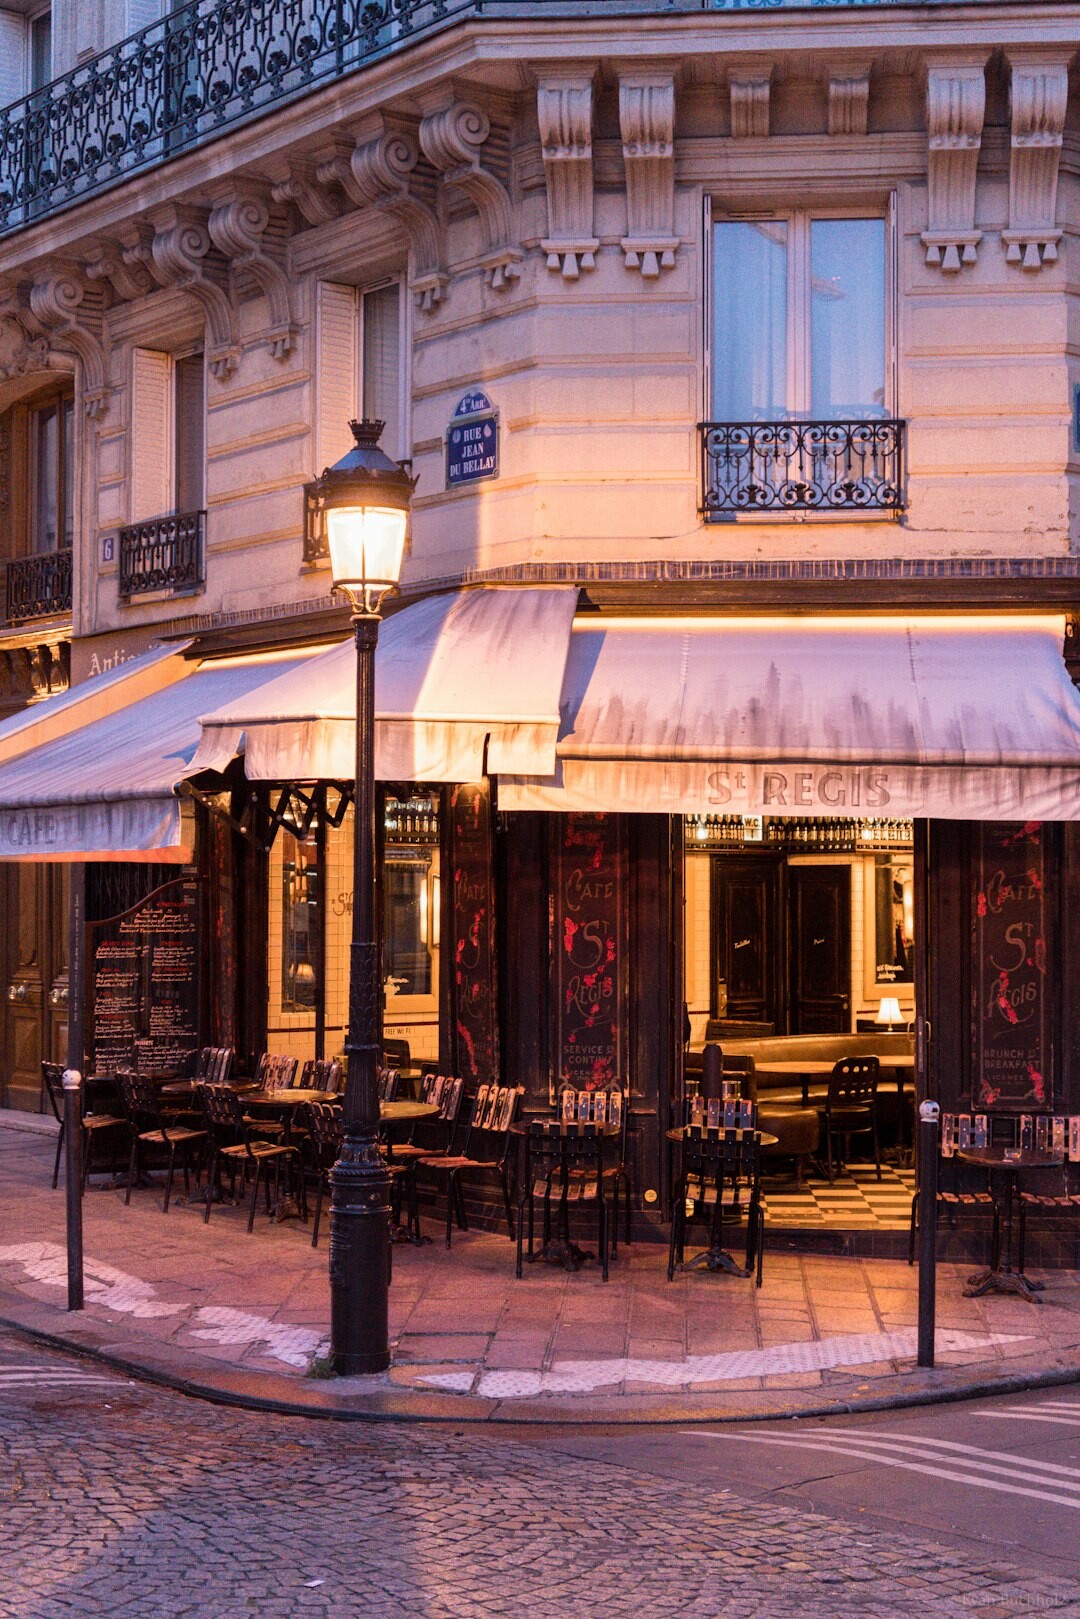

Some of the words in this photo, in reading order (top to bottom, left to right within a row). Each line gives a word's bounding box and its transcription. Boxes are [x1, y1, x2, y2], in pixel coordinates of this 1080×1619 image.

[463, 427, 482, 442] RUE
[461, 442, 484, 459] JEAN
[450, 462, 461, 477] DU
[463, 455, 496, 474] BELLAY
[105, 539, 111, 560] 6
[762, 771, 891, 808] REGIS
[563, 1045, 604, 1054] SERVICE
[984, 1048, 1024, 1059] BRUNCH
[984, 1059, 1040, 1069] BREAKFAST
